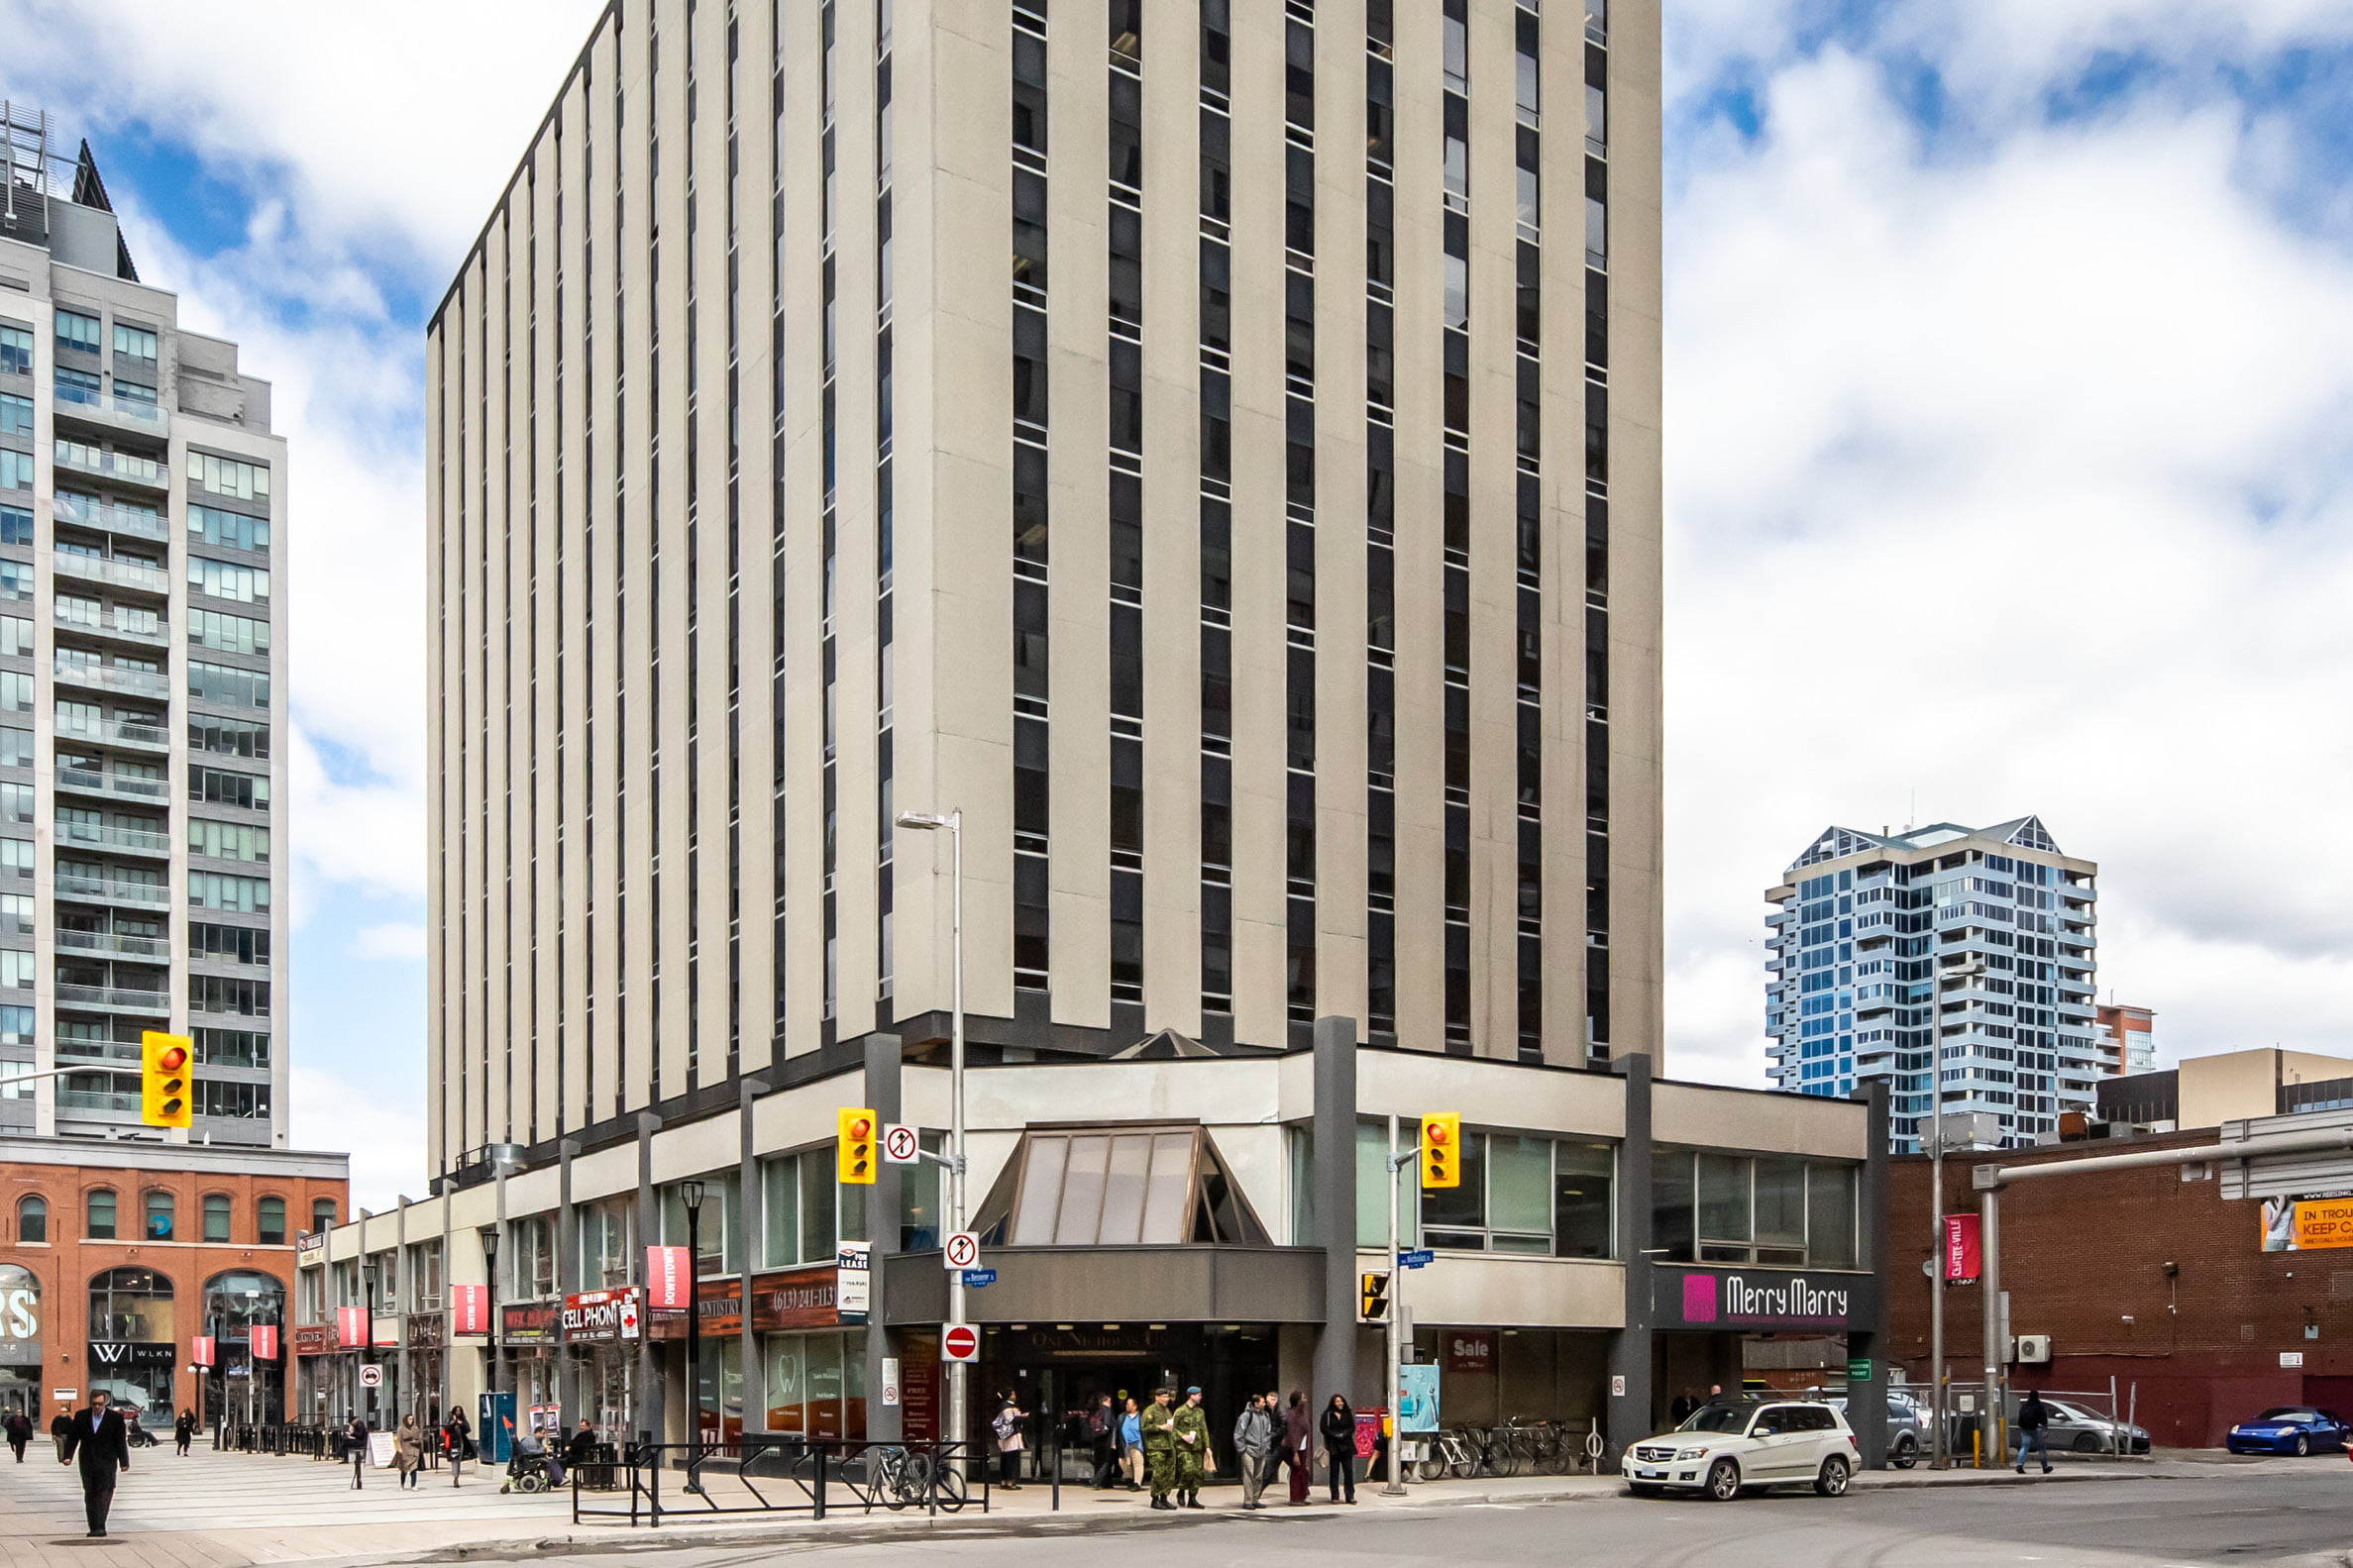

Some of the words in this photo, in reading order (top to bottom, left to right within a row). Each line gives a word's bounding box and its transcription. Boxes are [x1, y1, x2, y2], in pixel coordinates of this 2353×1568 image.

[2303, 1210, 2316, 1220] IN
[2303, 1222, 2337, 1235] KEEP
[2340, 1221, 2353, 1233] C
[1950, 1219, 1963, 1276] CENTRE-VILLE
[841, 1260, 868, 1269] LEASE
[663, 1248, 676, 1306] DOWNTOWN
[774, 1288, 797, 1312] (613)
[1727, 1276, 1786, 1314] Merry
[1791, 1278, 1848, 1315] Marry
[0, 1289, 37, 1338] S
[562, 1308, 583, 1329] CELL
[92, 1344, 126, 1362] W
[1454, 1339, 1488, 1356] Sale
